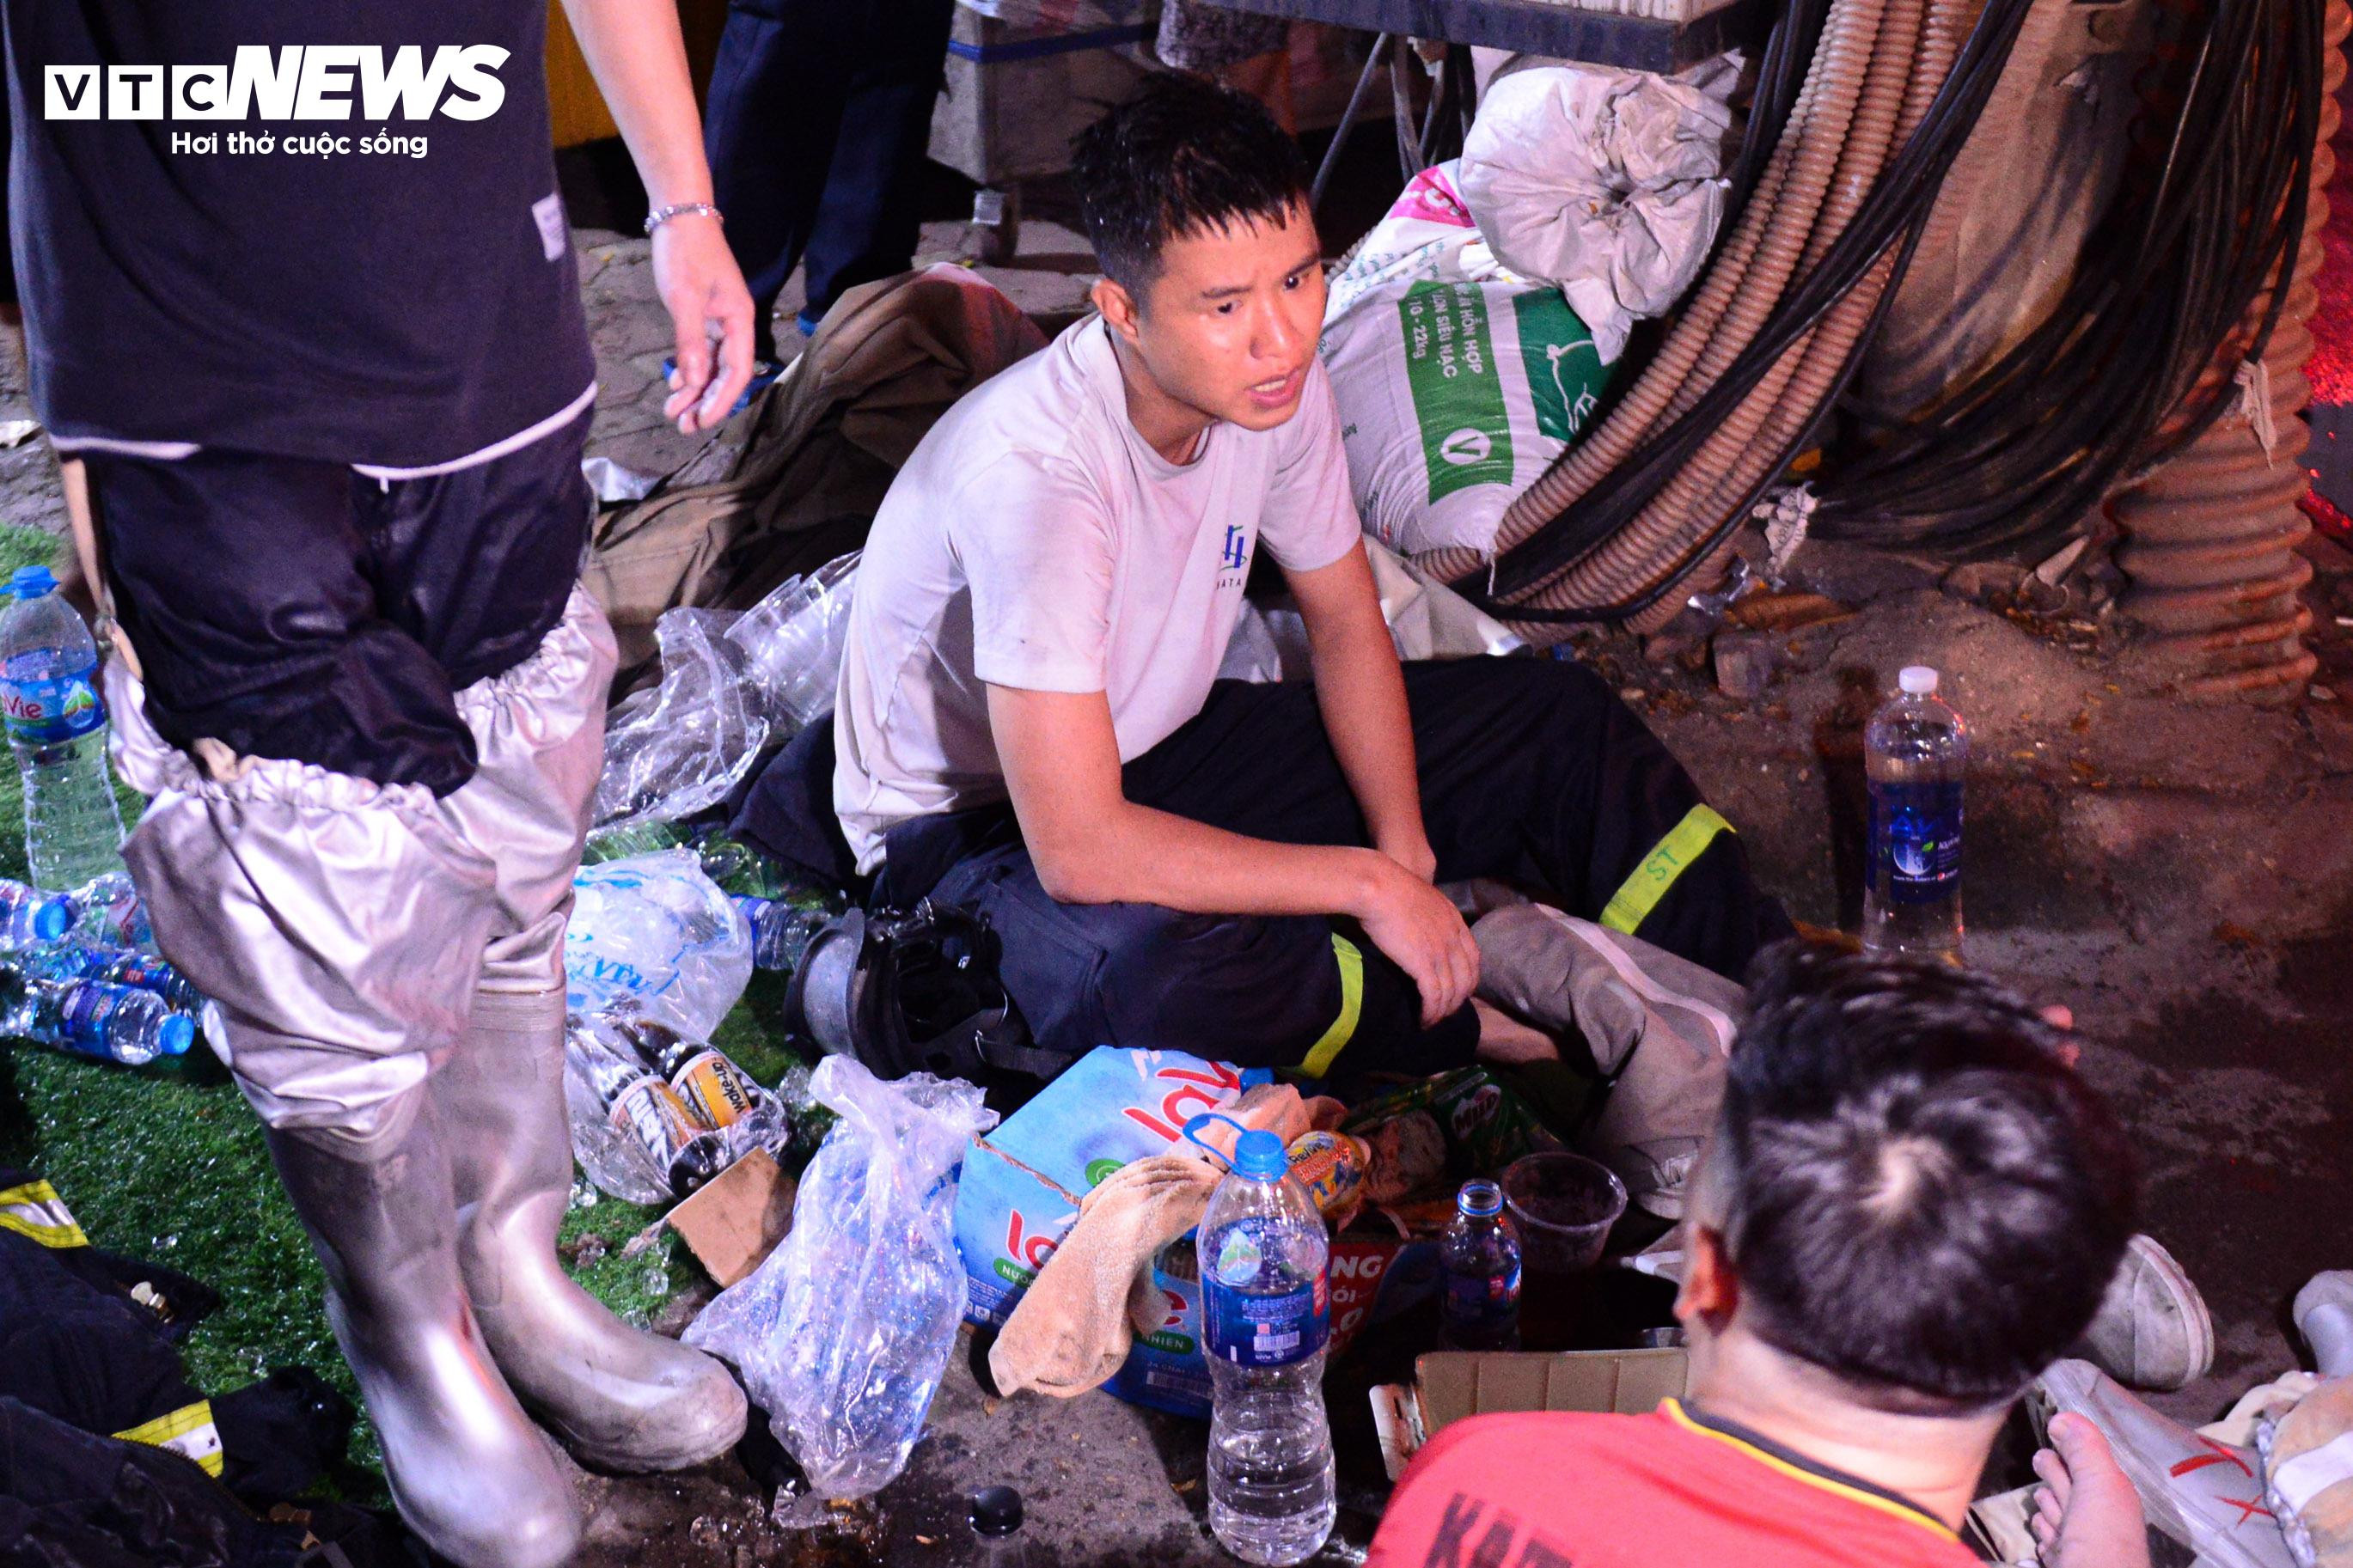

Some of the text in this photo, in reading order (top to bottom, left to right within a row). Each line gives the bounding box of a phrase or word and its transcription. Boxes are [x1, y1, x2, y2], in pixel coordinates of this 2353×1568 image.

[1436, 344, 1458, 378] NẠC
[1460, 339, 1484, 374] HỢP
[1646, 847, 1678, 881] ST
[710, 1061, 744, 1113] wake-up
[1329, 1254, 1385, 1278] NG
